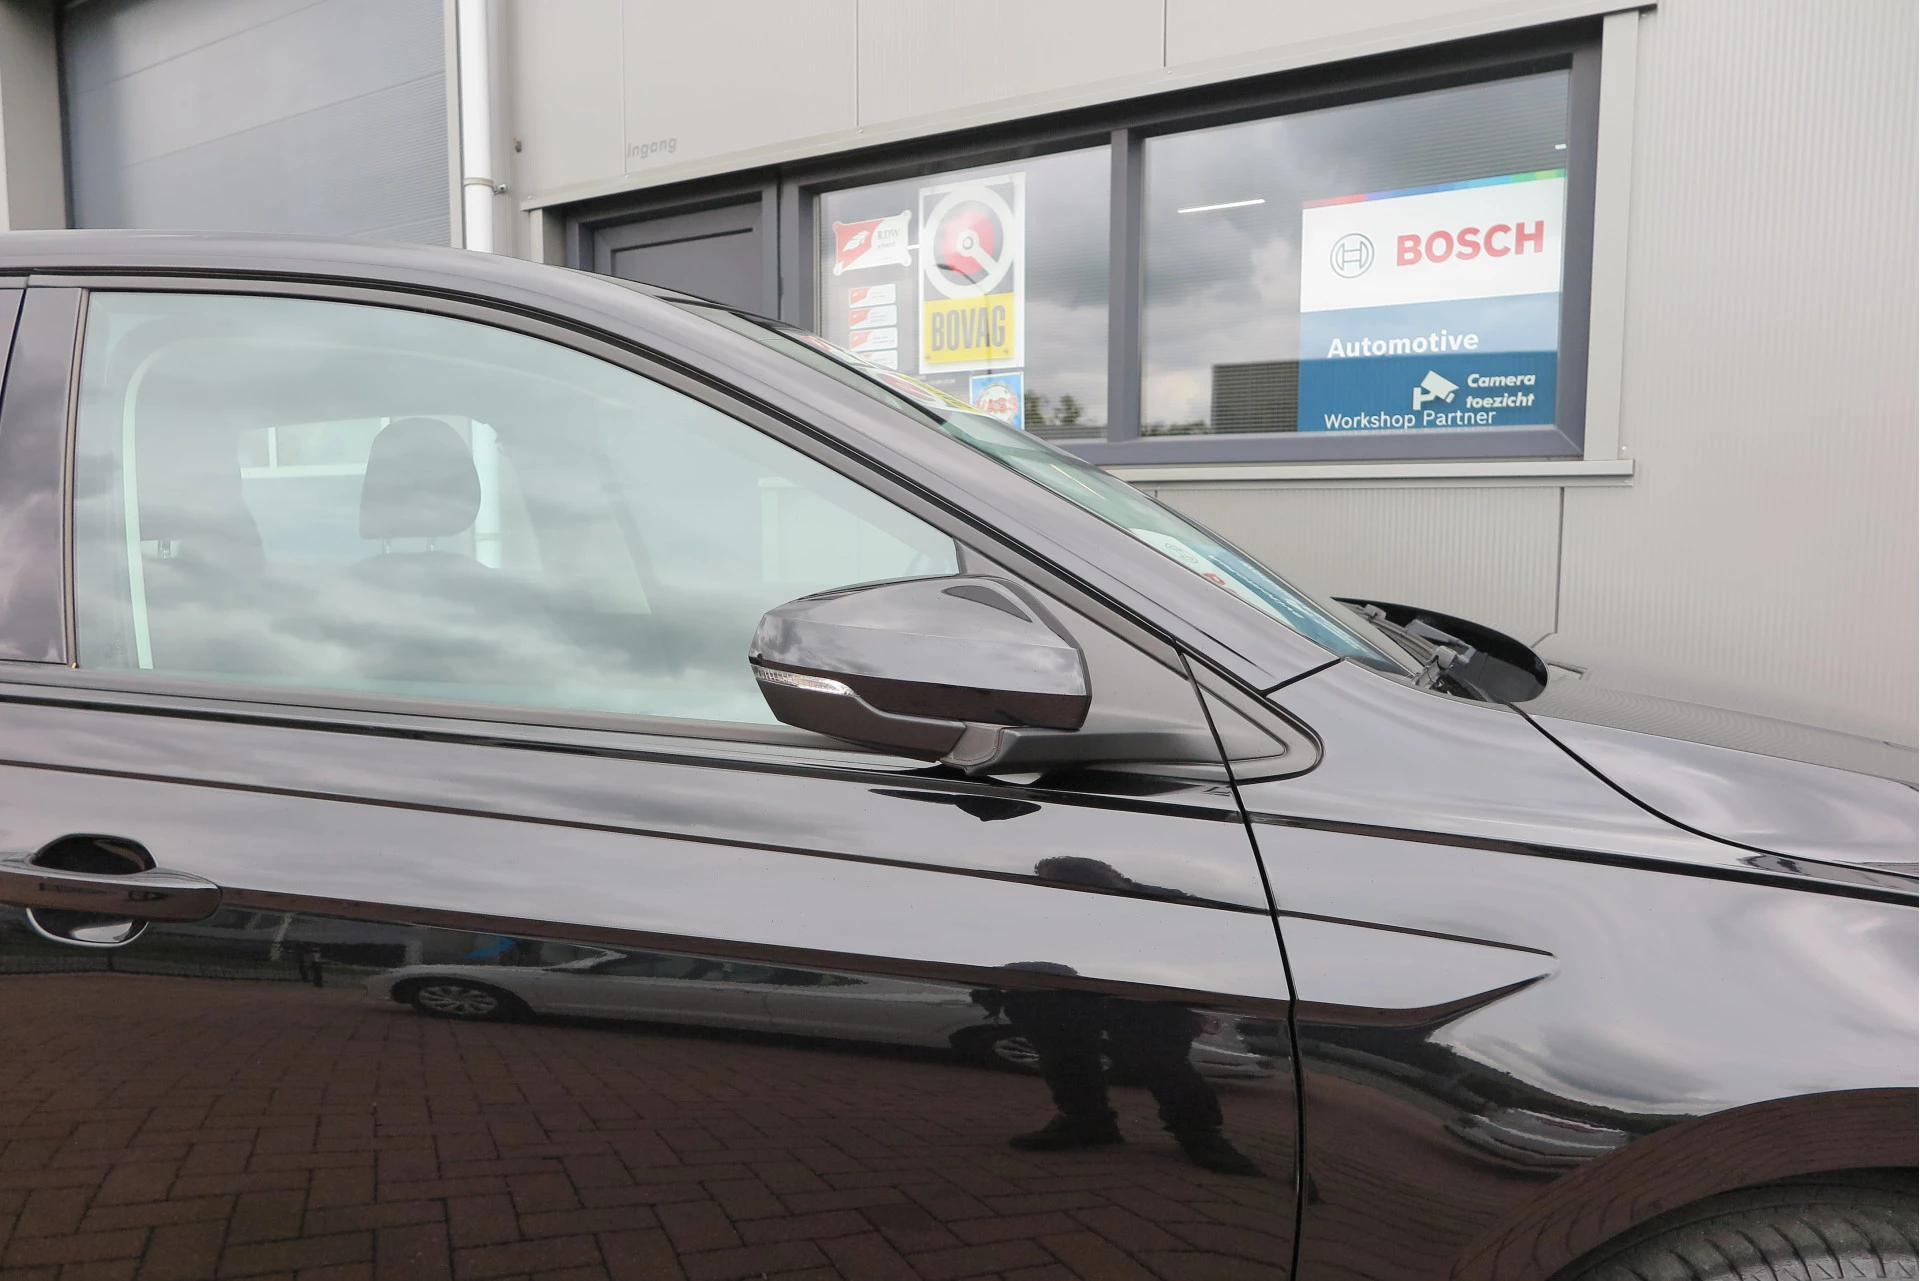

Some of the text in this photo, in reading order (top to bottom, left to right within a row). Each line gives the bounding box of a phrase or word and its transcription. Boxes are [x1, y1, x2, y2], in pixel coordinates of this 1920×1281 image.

[627, 138, 677, 158] Ingang
[877, 228, 901, 240] RDW
[1396, 220, 1545, 267] BOSCH
[932, 305, 1006, 351] BOVAG
[1327, 329, 1480, 358] Automotive
[1466, 373, 1536, 388] Camera
[976, 394, 1019, 413] VASS
[1466, 391, 1535, 408] toezicht
[1324, 409, 1497, 430] Workshop Partner
